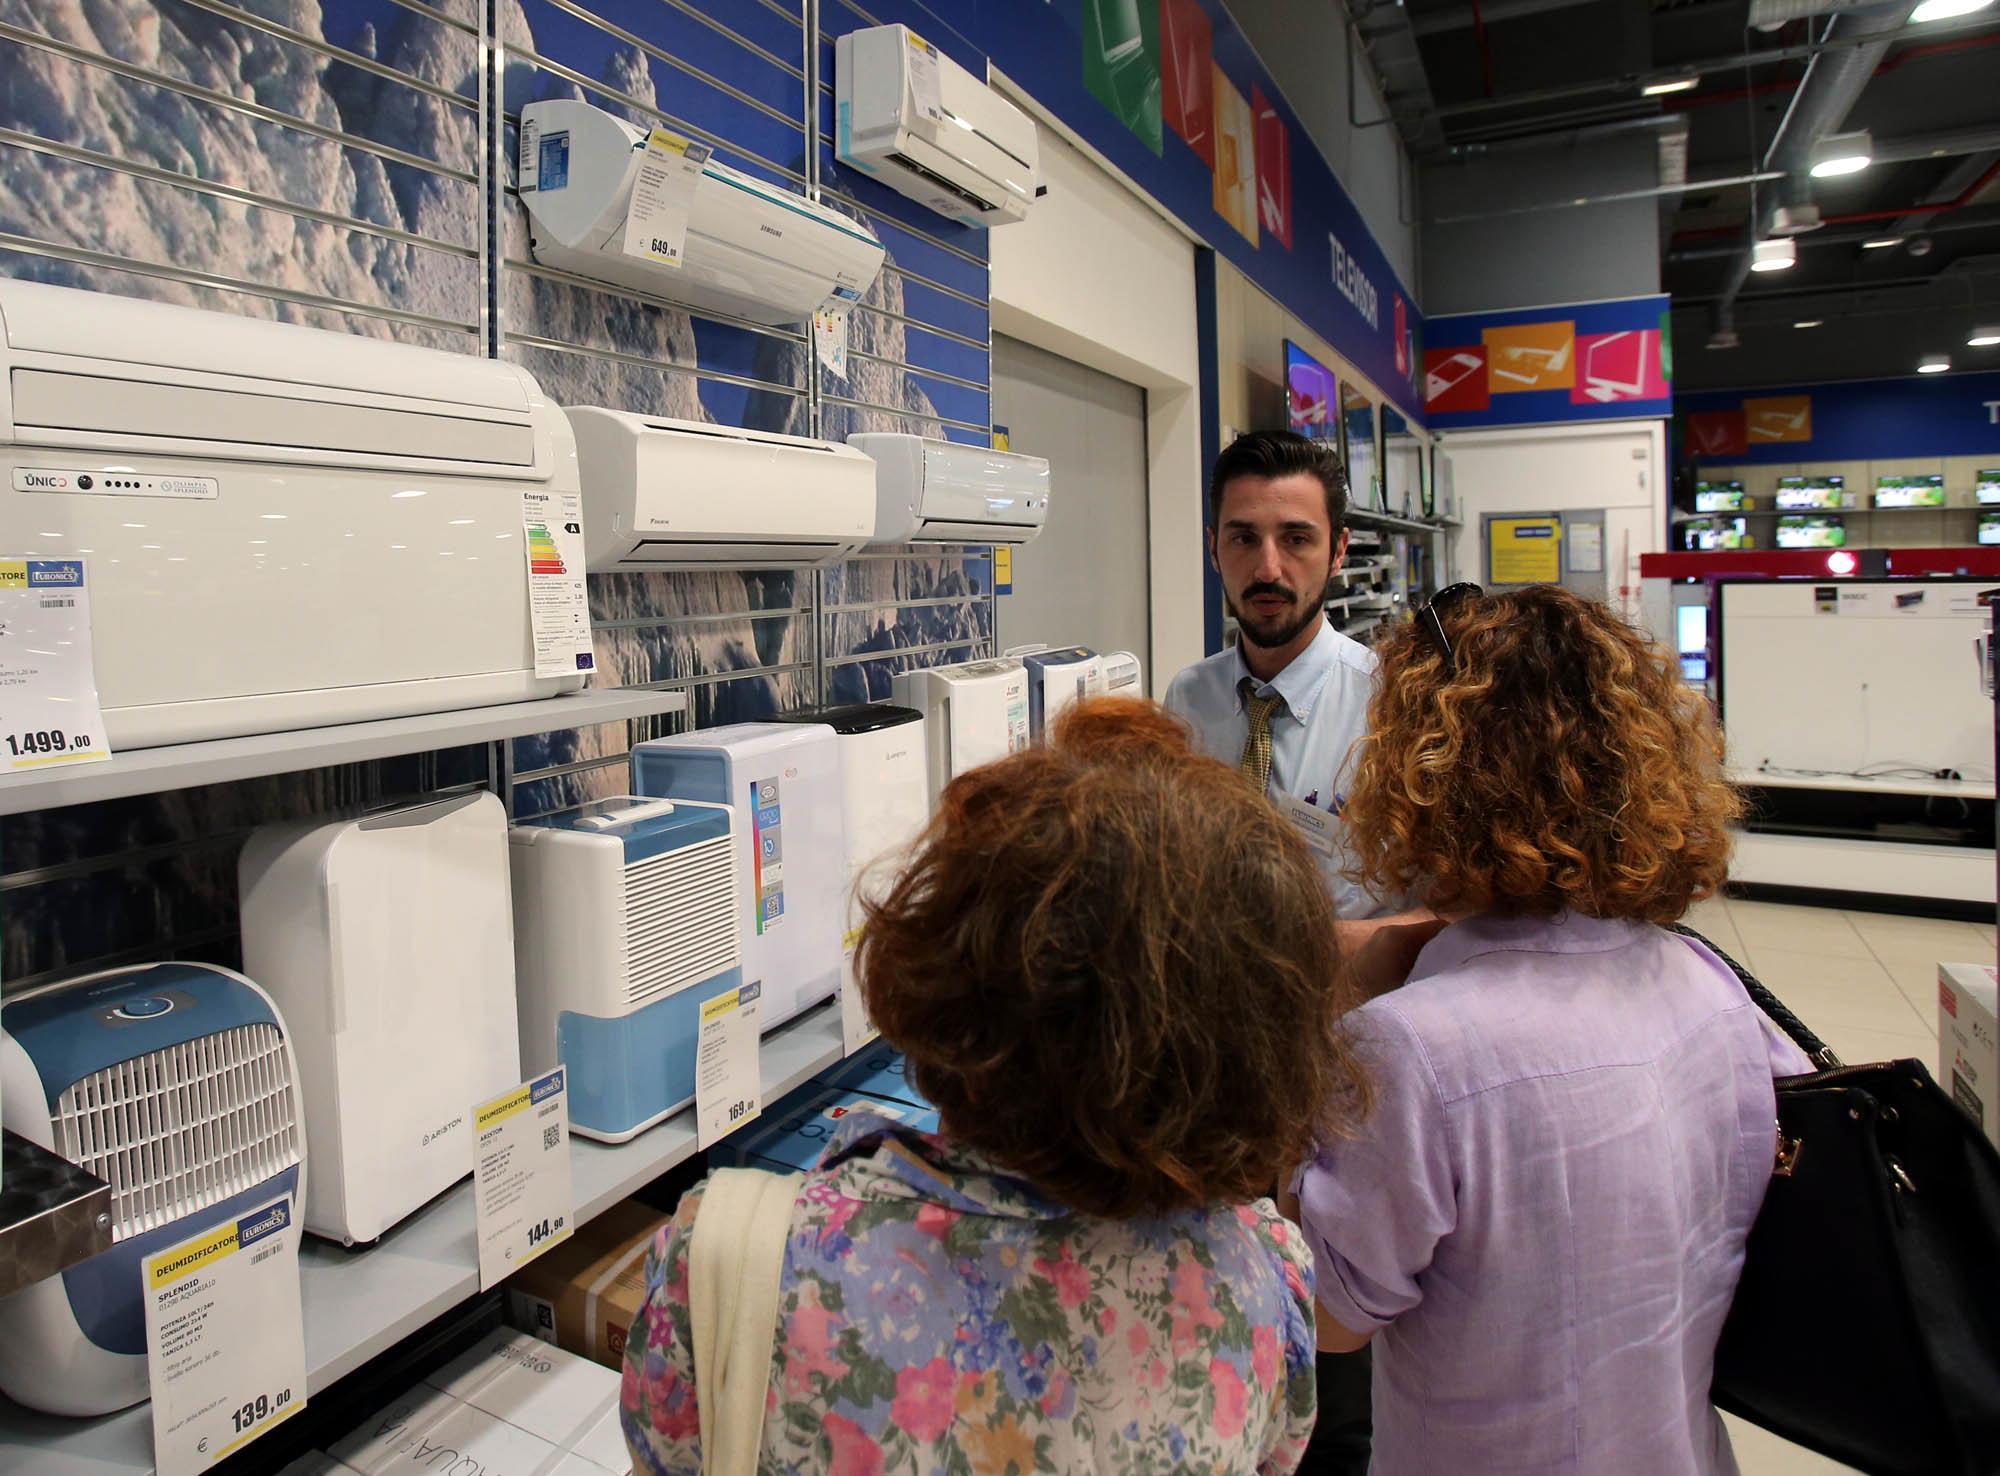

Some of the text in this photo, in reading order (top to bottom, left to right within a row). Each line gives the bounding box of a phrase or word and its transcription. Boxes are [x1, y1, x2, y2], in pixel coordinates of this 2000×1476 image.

[523, 492, 549, 501] Energia
[431, 1117, 462, 1141] ARISTON
[243, 1215, 284, 1242] EURONICS
[156, 1233, 240, 1278] DEUMIDIFICATORE
[158, 1278, 200, 1303] SPLENDID
[160, 1321, 190, 1340] CONSUMO
[197, 1437, 209, 1454] €
[230, 1387, 291, 1433] 139,00
